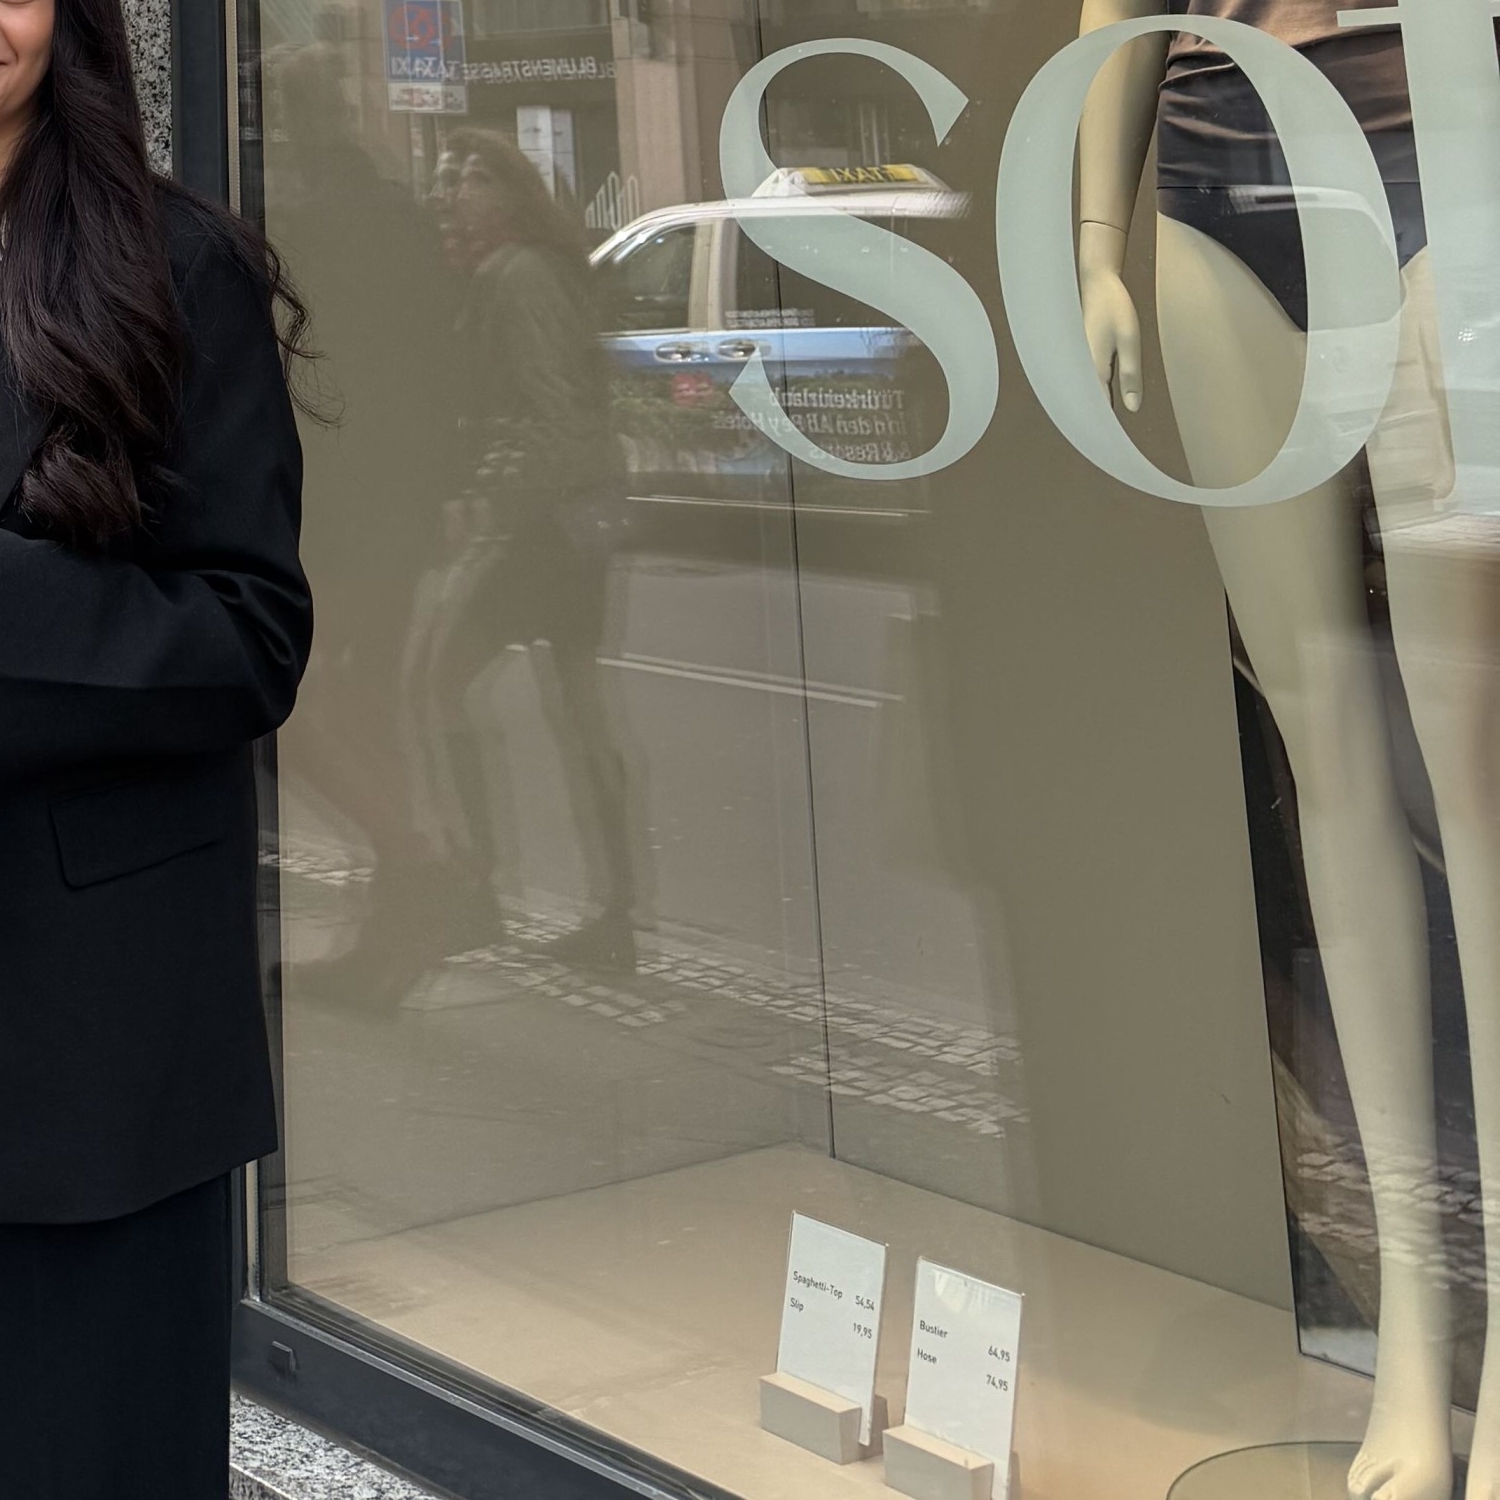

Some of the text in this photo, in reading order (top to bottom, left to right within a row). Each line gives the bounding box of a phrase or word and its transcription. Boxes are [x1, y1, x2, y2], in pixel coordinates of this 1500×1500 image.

[793, 1270, 843, 1300] Spaghetti-Top
[790, 1297, 804, 1312] Slip
[919, 1319, 948, 1338] Bustier
[917, 1347, 938, 1364] Hose
